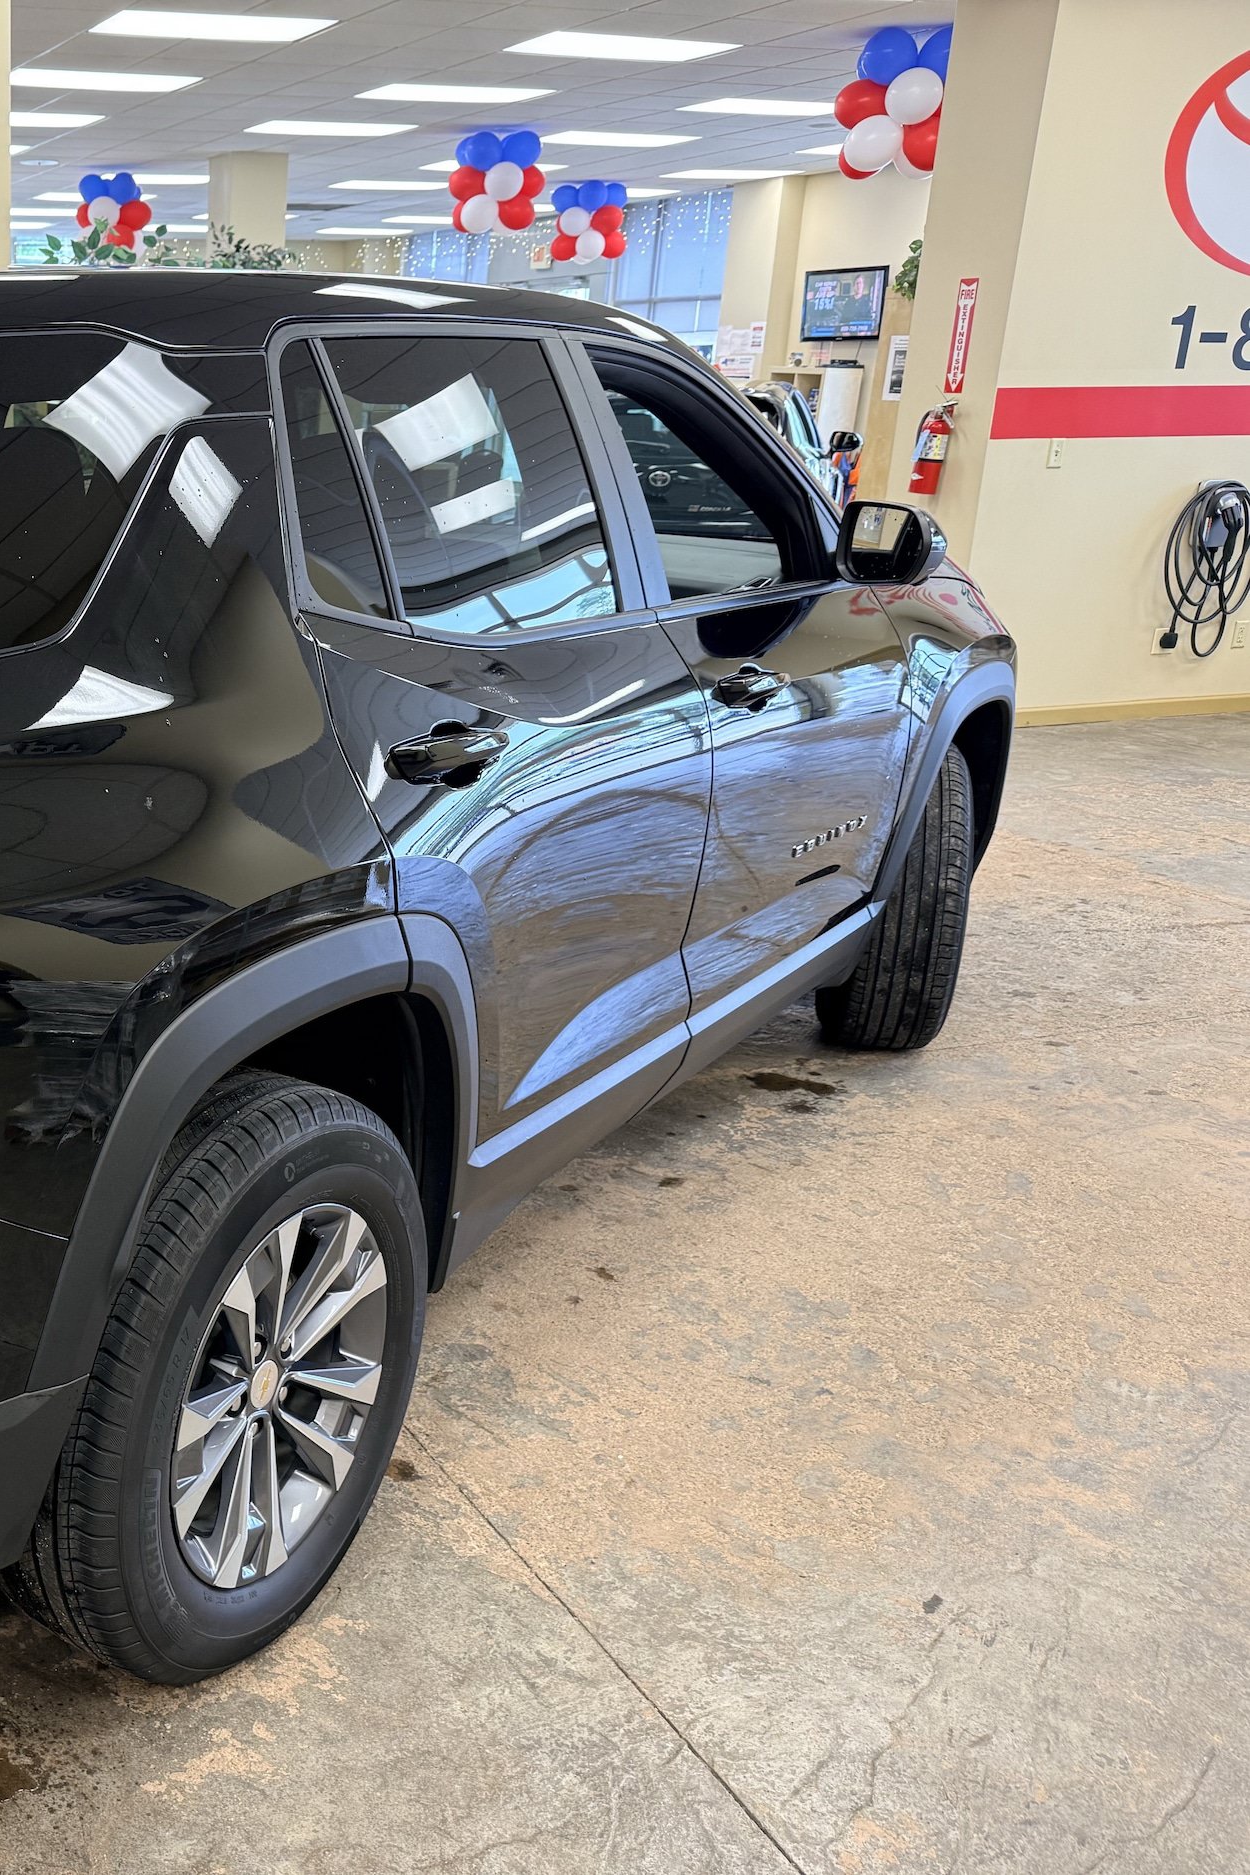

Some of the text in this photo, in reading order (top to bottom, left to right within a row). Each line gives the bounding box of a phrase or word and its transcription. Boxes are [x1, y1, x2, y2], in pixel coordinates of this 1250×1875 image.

[960, 288, 975, 300] FIRE
[951, 303, 969, 385] EXTINGUISHER
[791, 815, 868, 859] EQUINOX
[141, 1473, 171, 1610] MICHELIN
